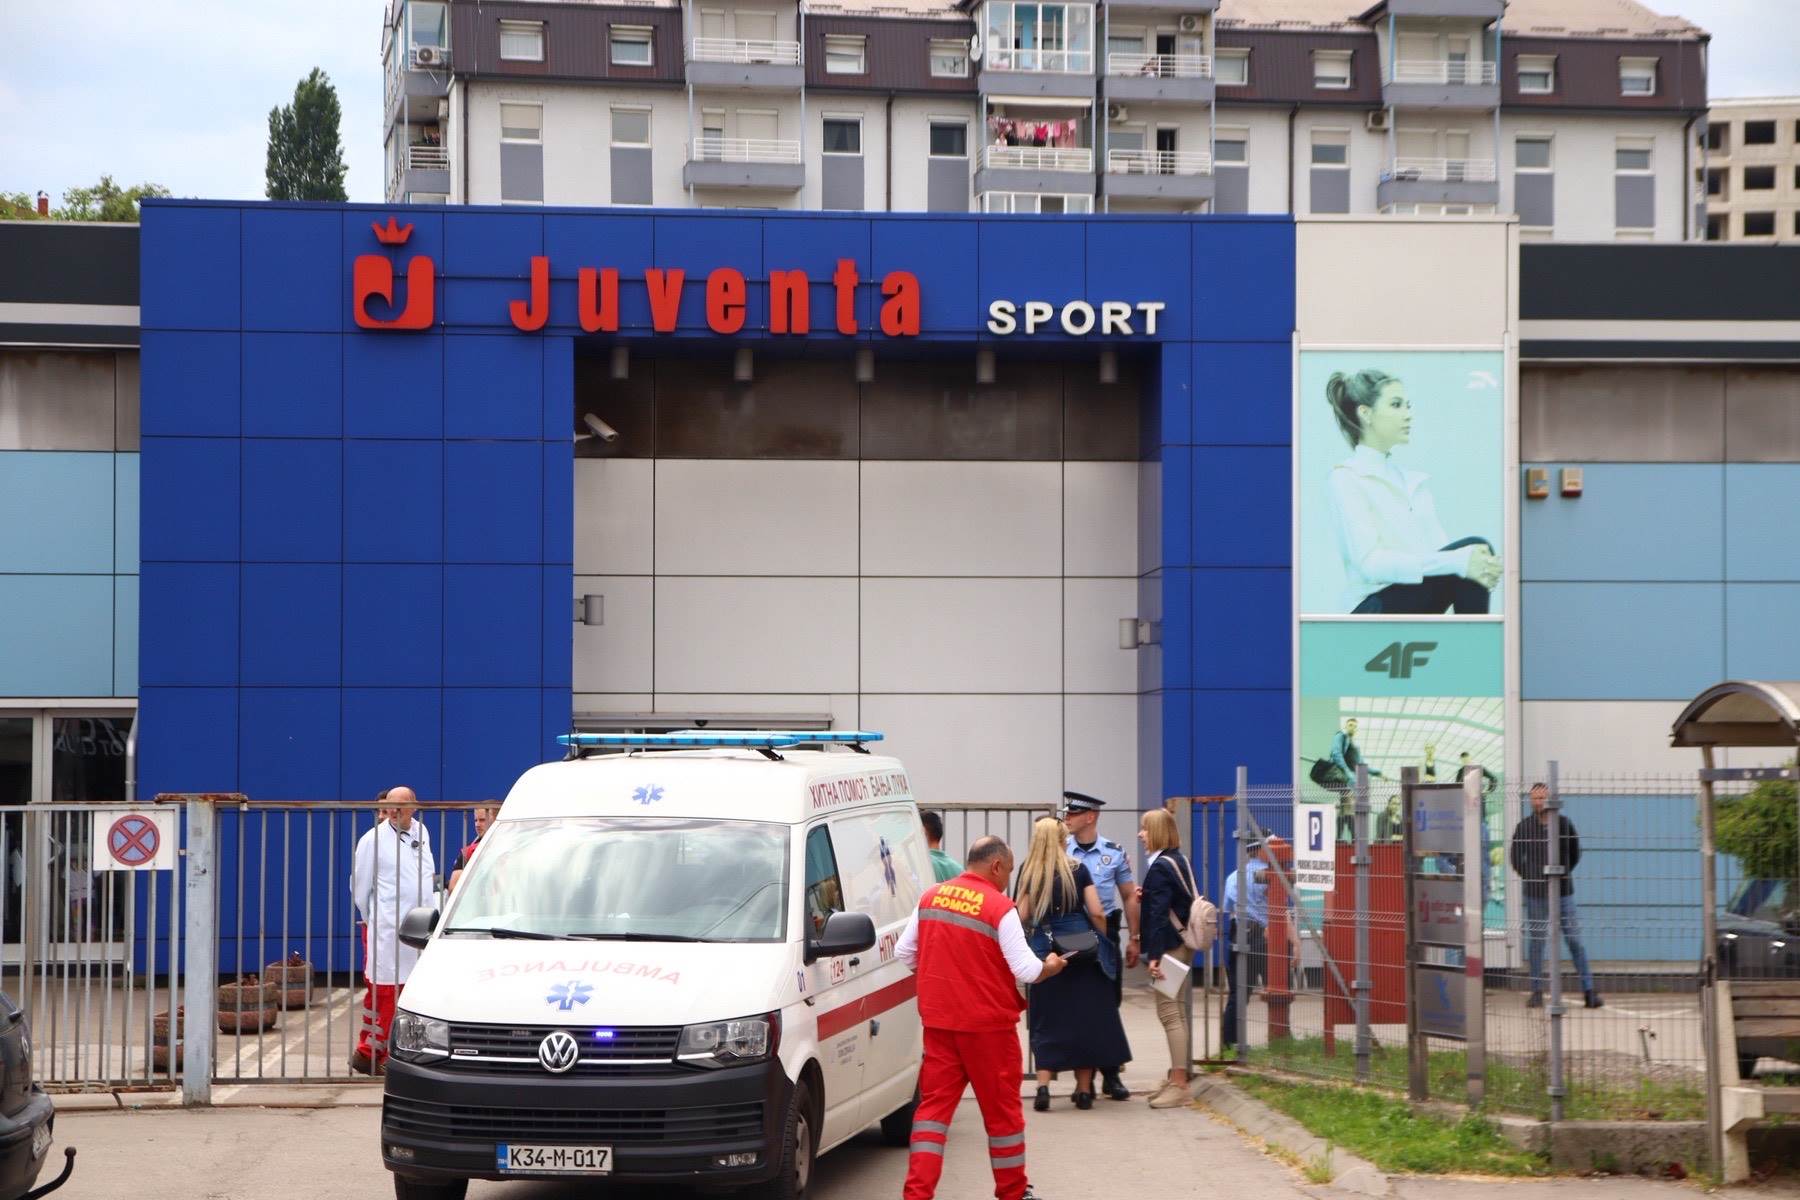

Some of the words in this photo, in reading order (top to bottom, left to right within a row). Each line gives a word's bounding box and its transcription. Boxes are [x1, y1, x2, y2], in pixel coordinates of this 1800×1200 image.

[509, 256, 920, 336] Juventa
[987, 300, 1166, 335] SPORT
[1365, 641, 1438, 679] 4F
[809, 781, 840, 809] ХИТНА
[510, 1148, 608, 1168] K34-M-017
